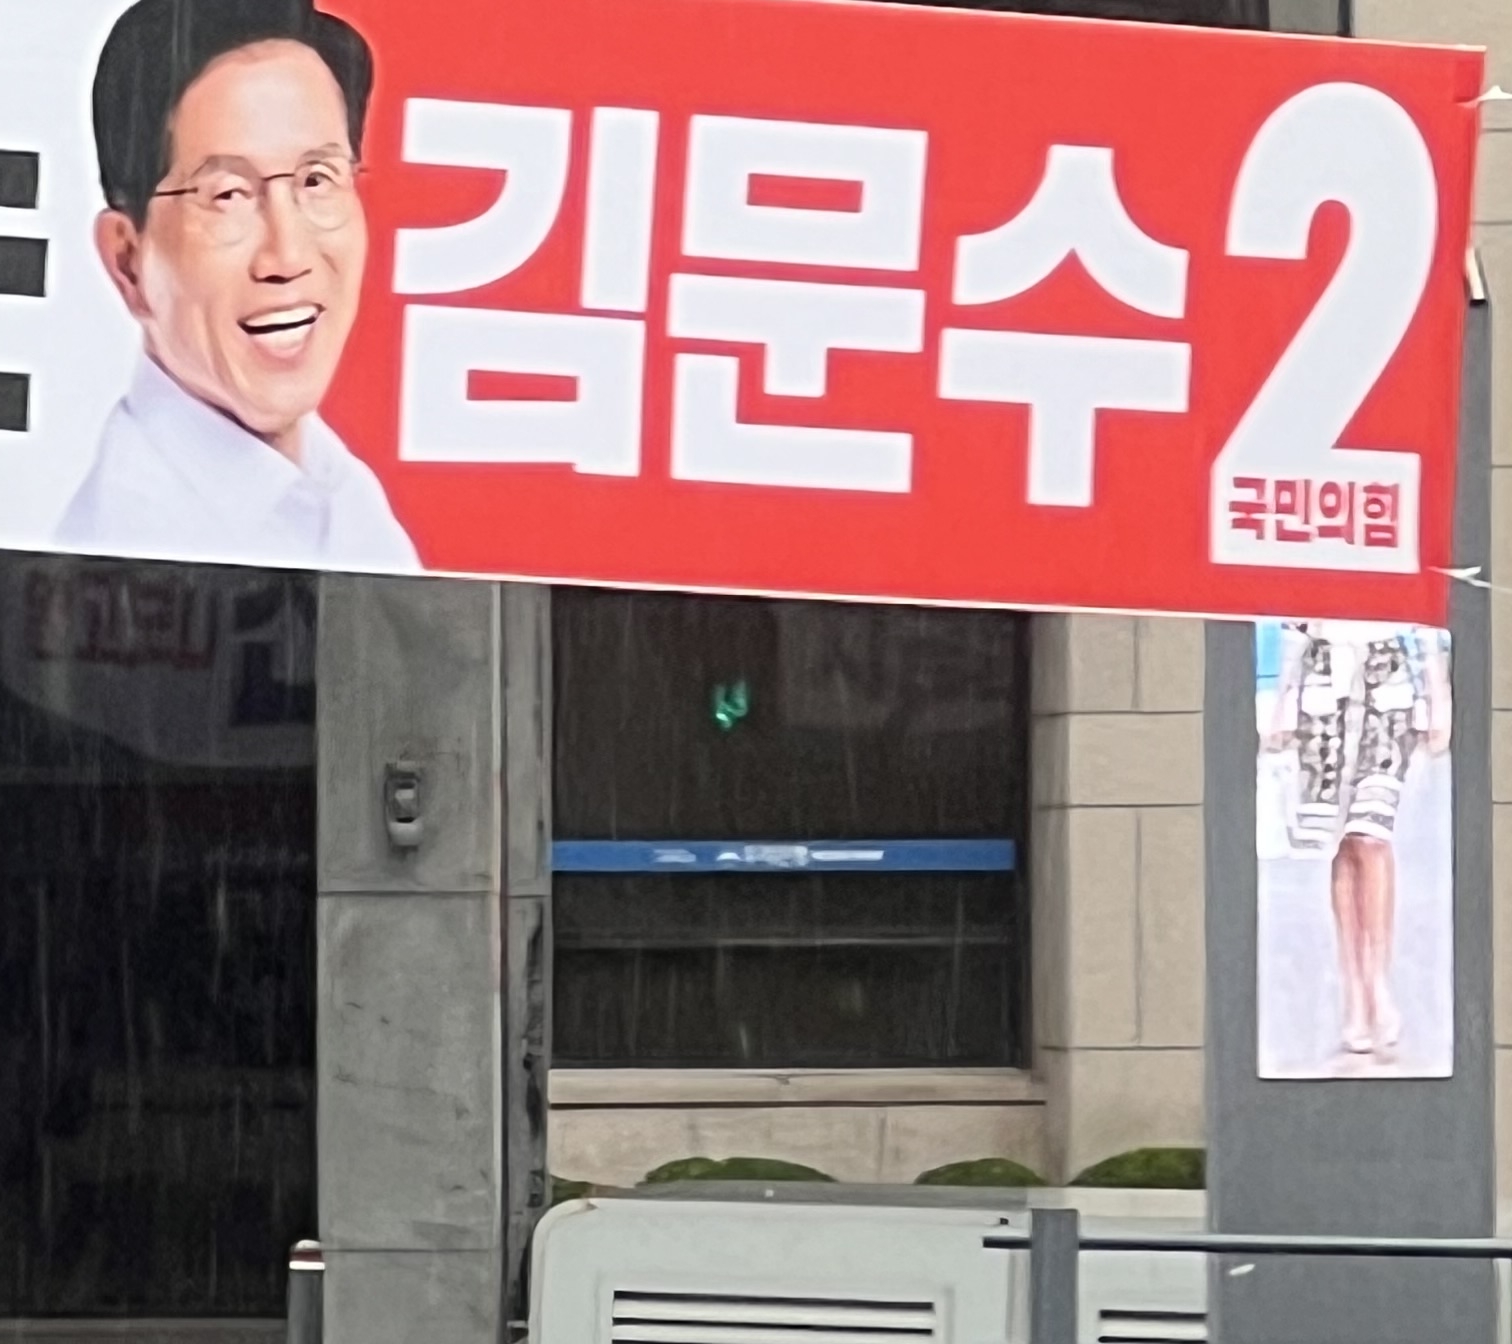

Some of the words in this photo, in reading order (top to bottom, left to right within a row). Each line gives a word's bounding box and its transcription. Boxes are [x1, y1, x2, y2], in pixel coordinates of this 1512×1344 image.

[392, 97, 1192, 508] 김문수
[1209, 81, 1439, 575] 2
[1228, 475, 1400, 549] 국민의힘
